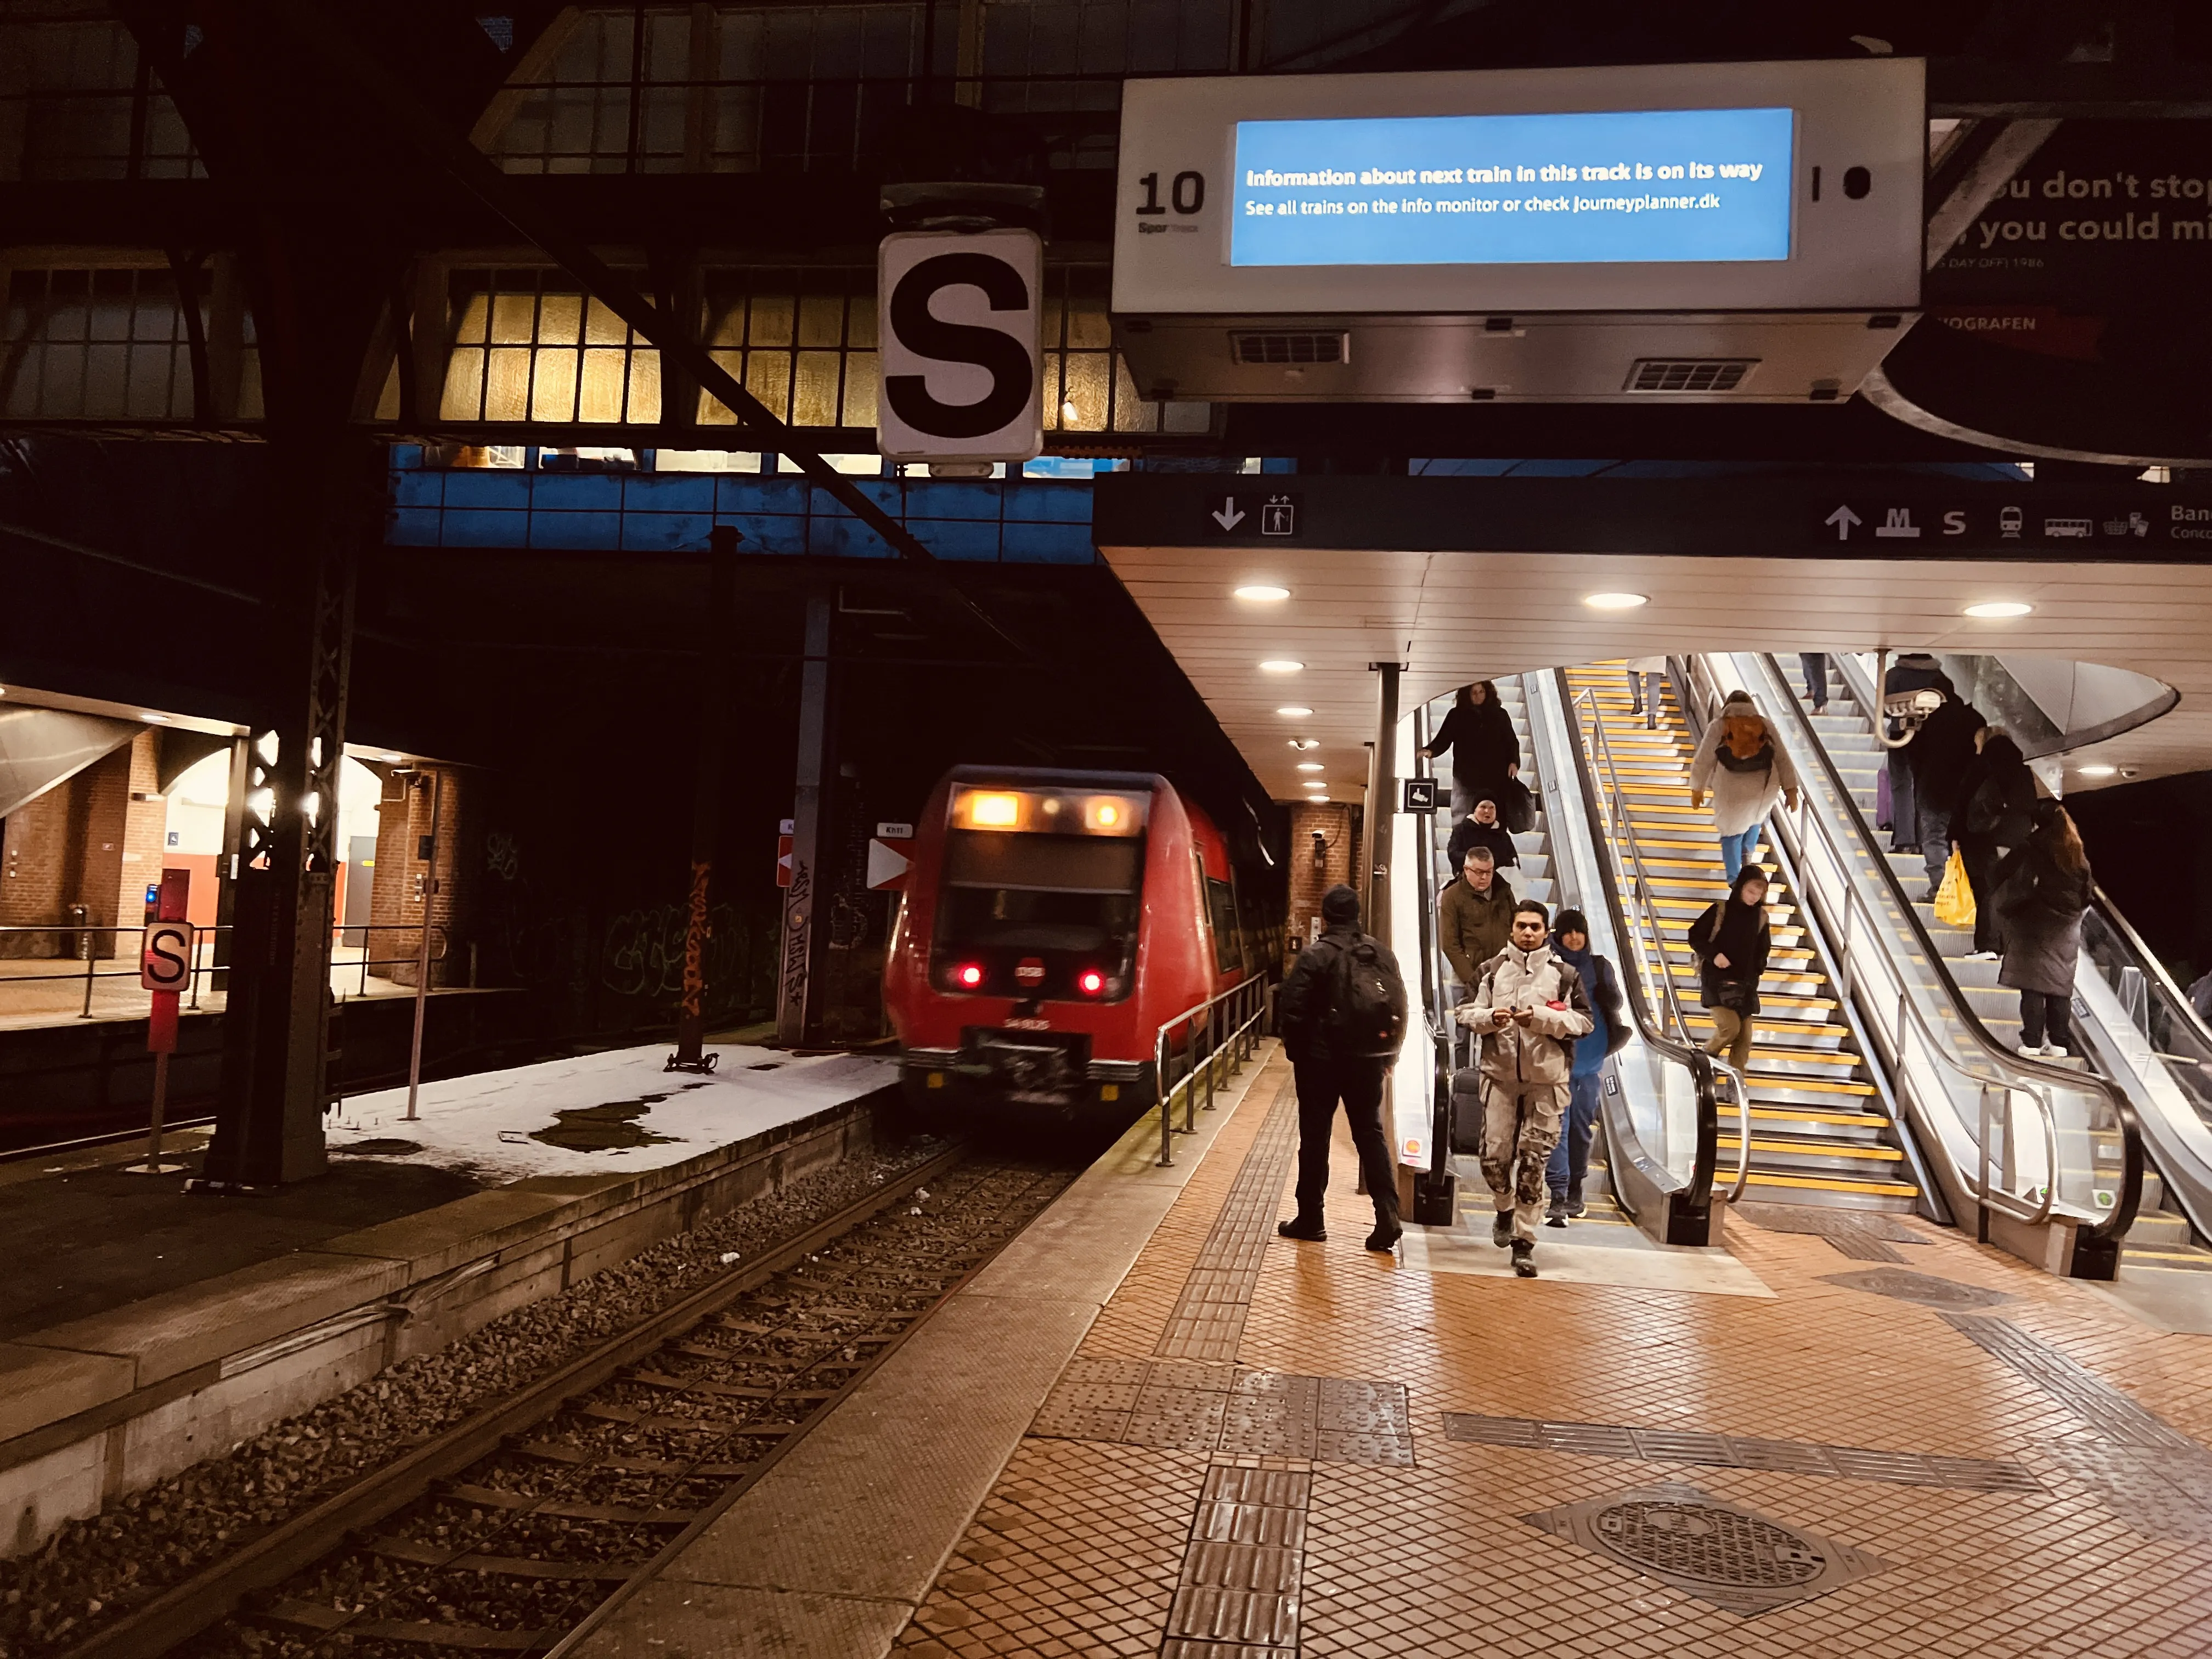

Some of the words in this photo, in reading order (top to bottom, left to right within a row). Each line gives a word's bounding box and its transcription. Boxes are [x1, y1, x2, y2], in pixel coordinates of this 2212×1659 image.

[1136, 171, 1205, 215] 10
[1246, 168, 1356, 187] Information
[1360, 167, 1417, 184] about
[1420, 168, 1463, 184] next
[1467, 165, 1512, 183] train
[1516, 165, 1536, 182] in
[1539, 163, 1578, 182] this
[1581, 162, 1631, 181] track
[1635, 162, 1654, 180] is
[1657, 165, 1684, 179] on
[1689, 162, 1715, 179] its
[1719, 163, 1763, 181] way
[2042, 170, 2140, 199] don't
[2150, 174, 2212, 207] sto
[1245, 200, 1274, 216] See
[1277, 199, 1297, 215] all
[1301, 199, 1344, 215] trains
[1347, 201, 1368, 214] on
[1372, 198, 1398, 213] the
[1401, 197, 1432, 213] info
[1436, 196, 1499, 213] monitor
[1502, 198, 1521, 212] or
[1524, 195, 1570, 212] check
[1572, 193, 1721, 213] Journeyplanner.dk
[1979, 220, 2047, 250] you
[2058, 211, 2160, 241] could
[885, 252, 1033, 439] S
[1943, 511, 1966, 535] S
[2171, 505, 2212, 521] Ban
[148, 929, 185, 984] S
